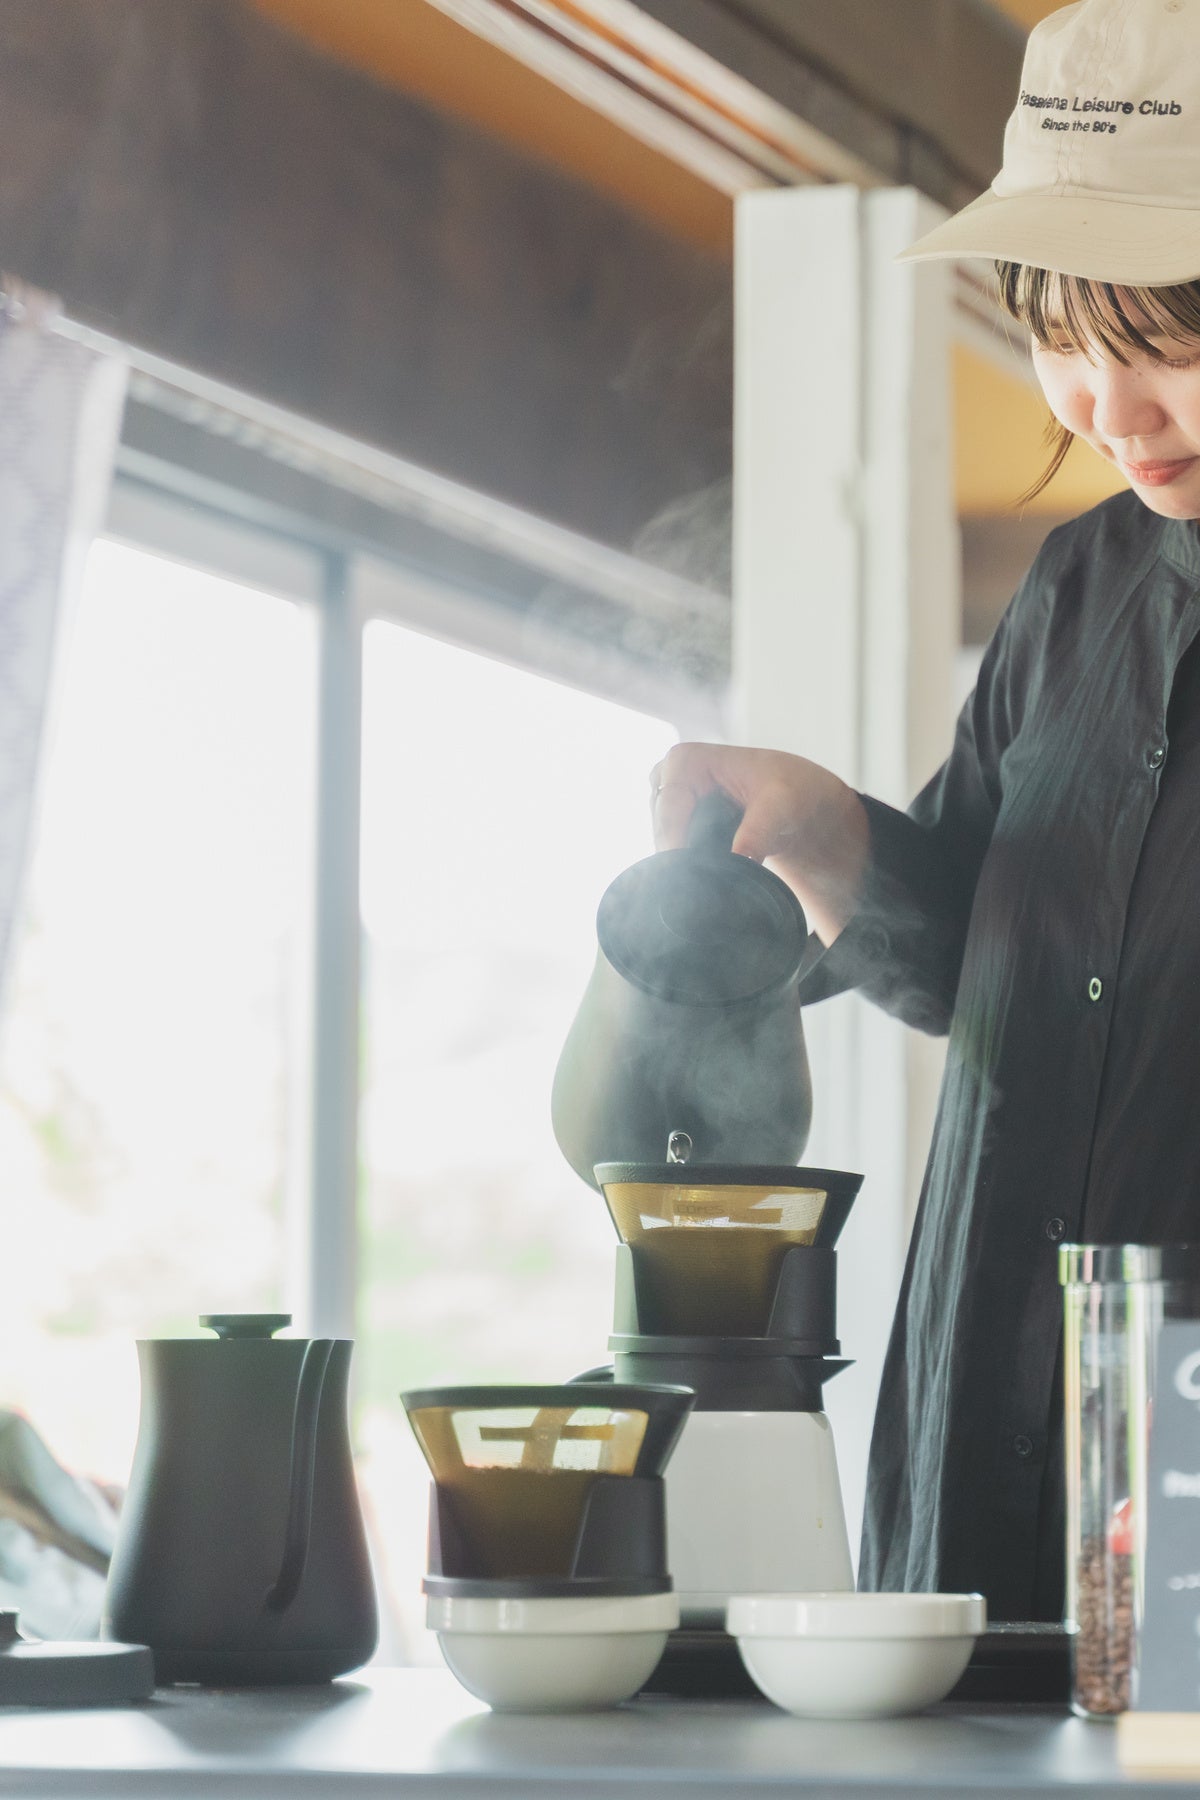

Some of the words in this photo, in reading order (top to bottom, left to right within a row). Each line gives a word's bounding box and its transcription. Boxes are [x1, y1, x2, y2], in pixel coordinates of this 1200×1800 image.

[1072, 97, 1134, 115] Leisure
[1139, 100, 1182, 116] Club
[1042, 118, 1069, 131] Since
[1072, 119, 1090, 132] the
[1092, 121, 1117, 134] 90's
